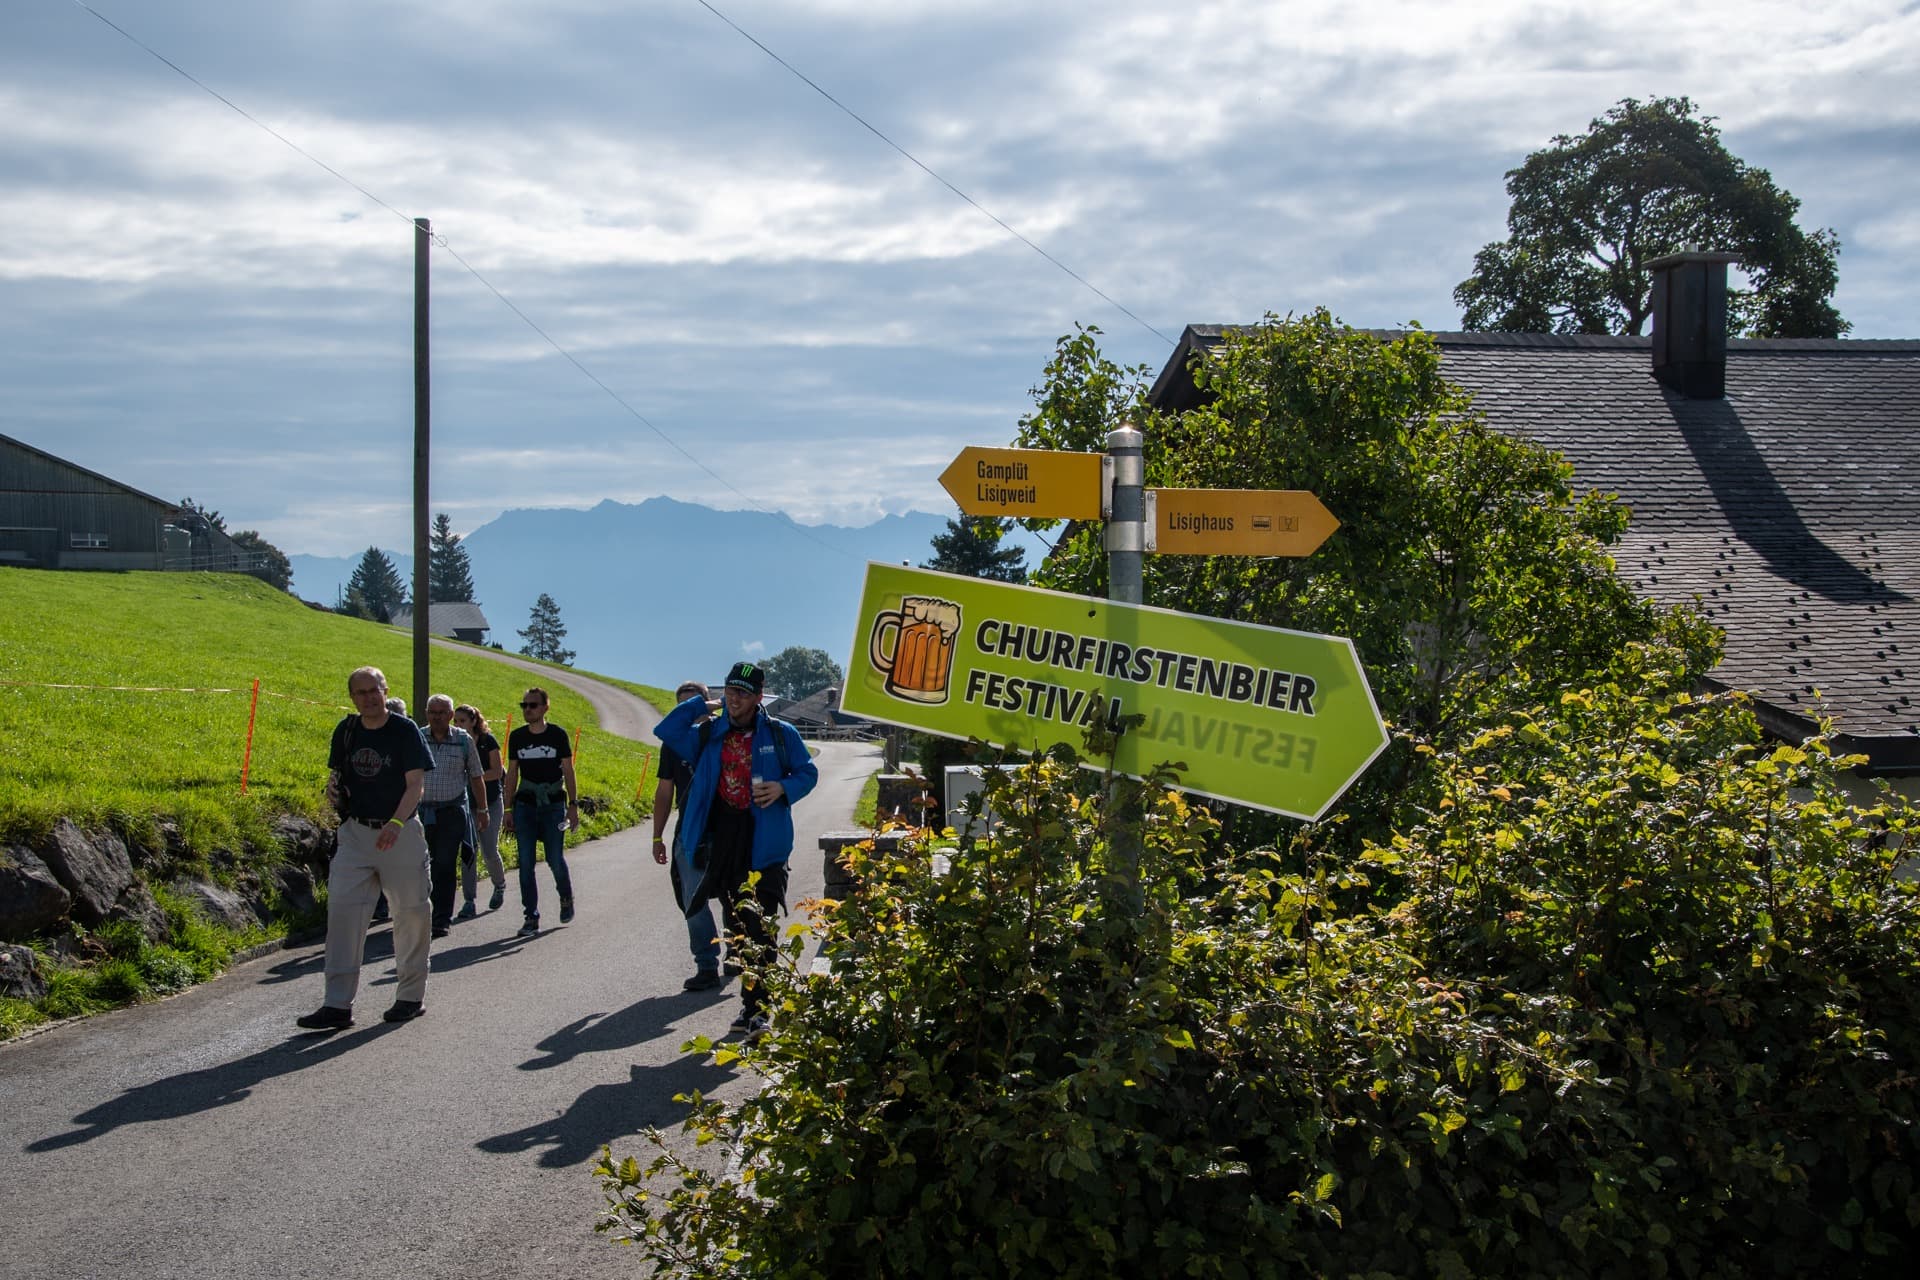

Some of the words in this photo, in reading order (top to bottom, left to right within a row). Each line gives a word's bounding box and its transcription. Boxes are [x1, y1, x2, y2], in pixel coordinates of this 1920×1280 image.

[978, 460, 1028, 484] Gamplüt
[978, 483, 1036, 506] Lisigweid
[1169, 511, 1234, 534] Lisighaus
[977, 619, 1317, 714] CHURFIRSTENBIER
